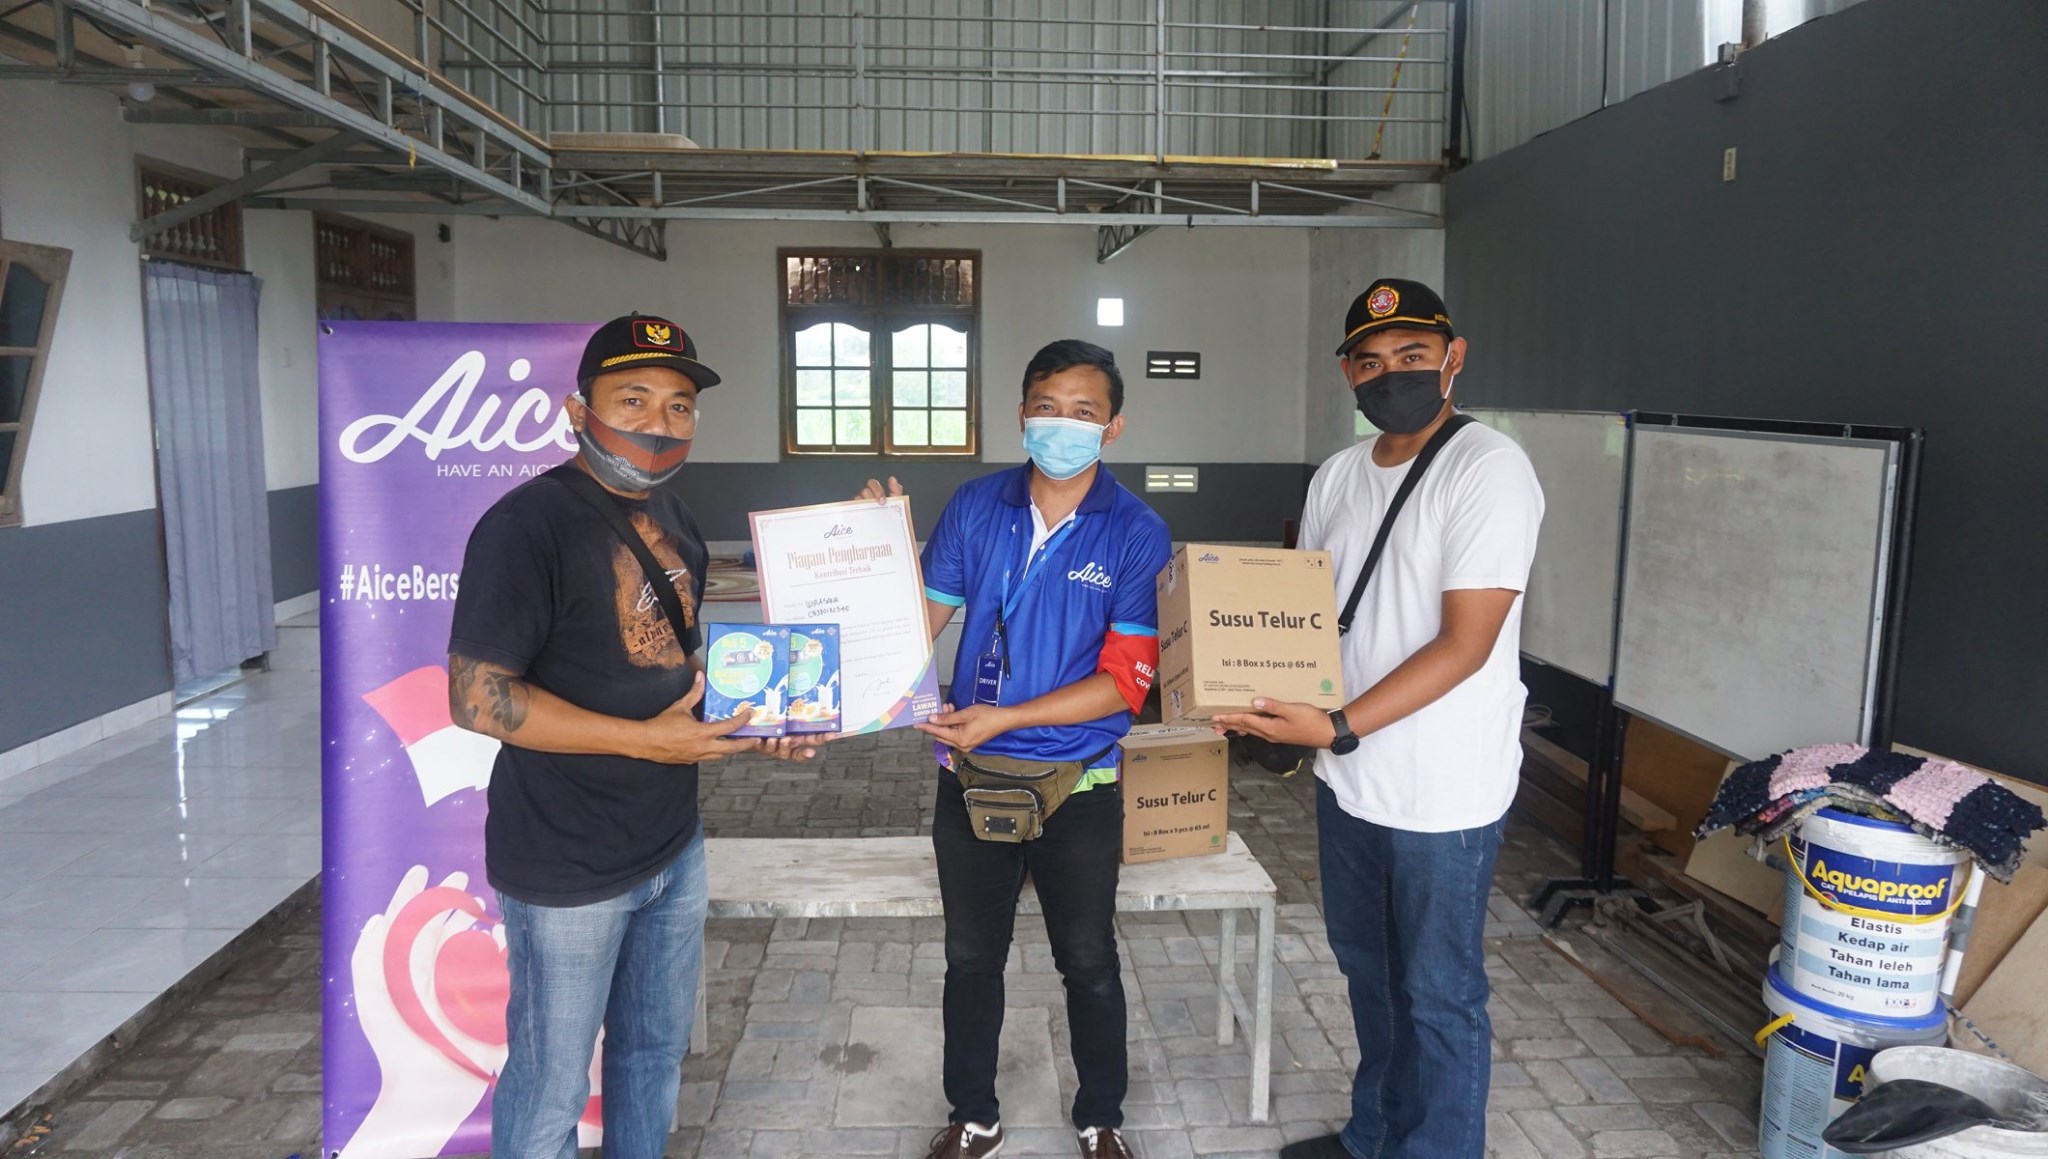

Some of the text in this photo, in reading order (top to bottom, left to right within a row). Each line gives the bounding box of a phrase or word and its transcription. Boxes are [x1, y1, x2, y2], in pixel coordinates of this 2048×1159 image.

[437, 464, 560, 477] HAVE AN AIC
[824, 524, 853, 538] Aice
[787, 543, 893, 570] Piagam Penghargaan
[340, 564, 460, 601] #AiceBers
[1068, 561, 1112, 588] Aice
[1209, 609, 1322, 630] Susu Telur C
[1222, 659, 1231, 667] Isi
[1236, 659, 1241, 667] 8
[1243, 659, 1258, 667] Box
[1266, 660, 1271, 668] 5
[1273, 661, 1286, 669] pcs
[1295, 660, 1305, 668] 65
[1307, 661, 1317, 669] ml
[979, 678, 998, 686] DRIVER
[912, 700, 937, 711] LAWAN
[1136, 789, 1217, 809] Susu Telur C
[1811, 859, 1945, 901] Aquaproof
[1821, 882, 1932, 906] CAT PELAPIS ANTI BOCOR
[1851, 917, 1902, 935] Elastis
[1838, 931, 1910, 953] Kedap air
[1830, 948, 1913, 972] Tahan leleh
[1828, 965, 1910, 990] Tahan lama
